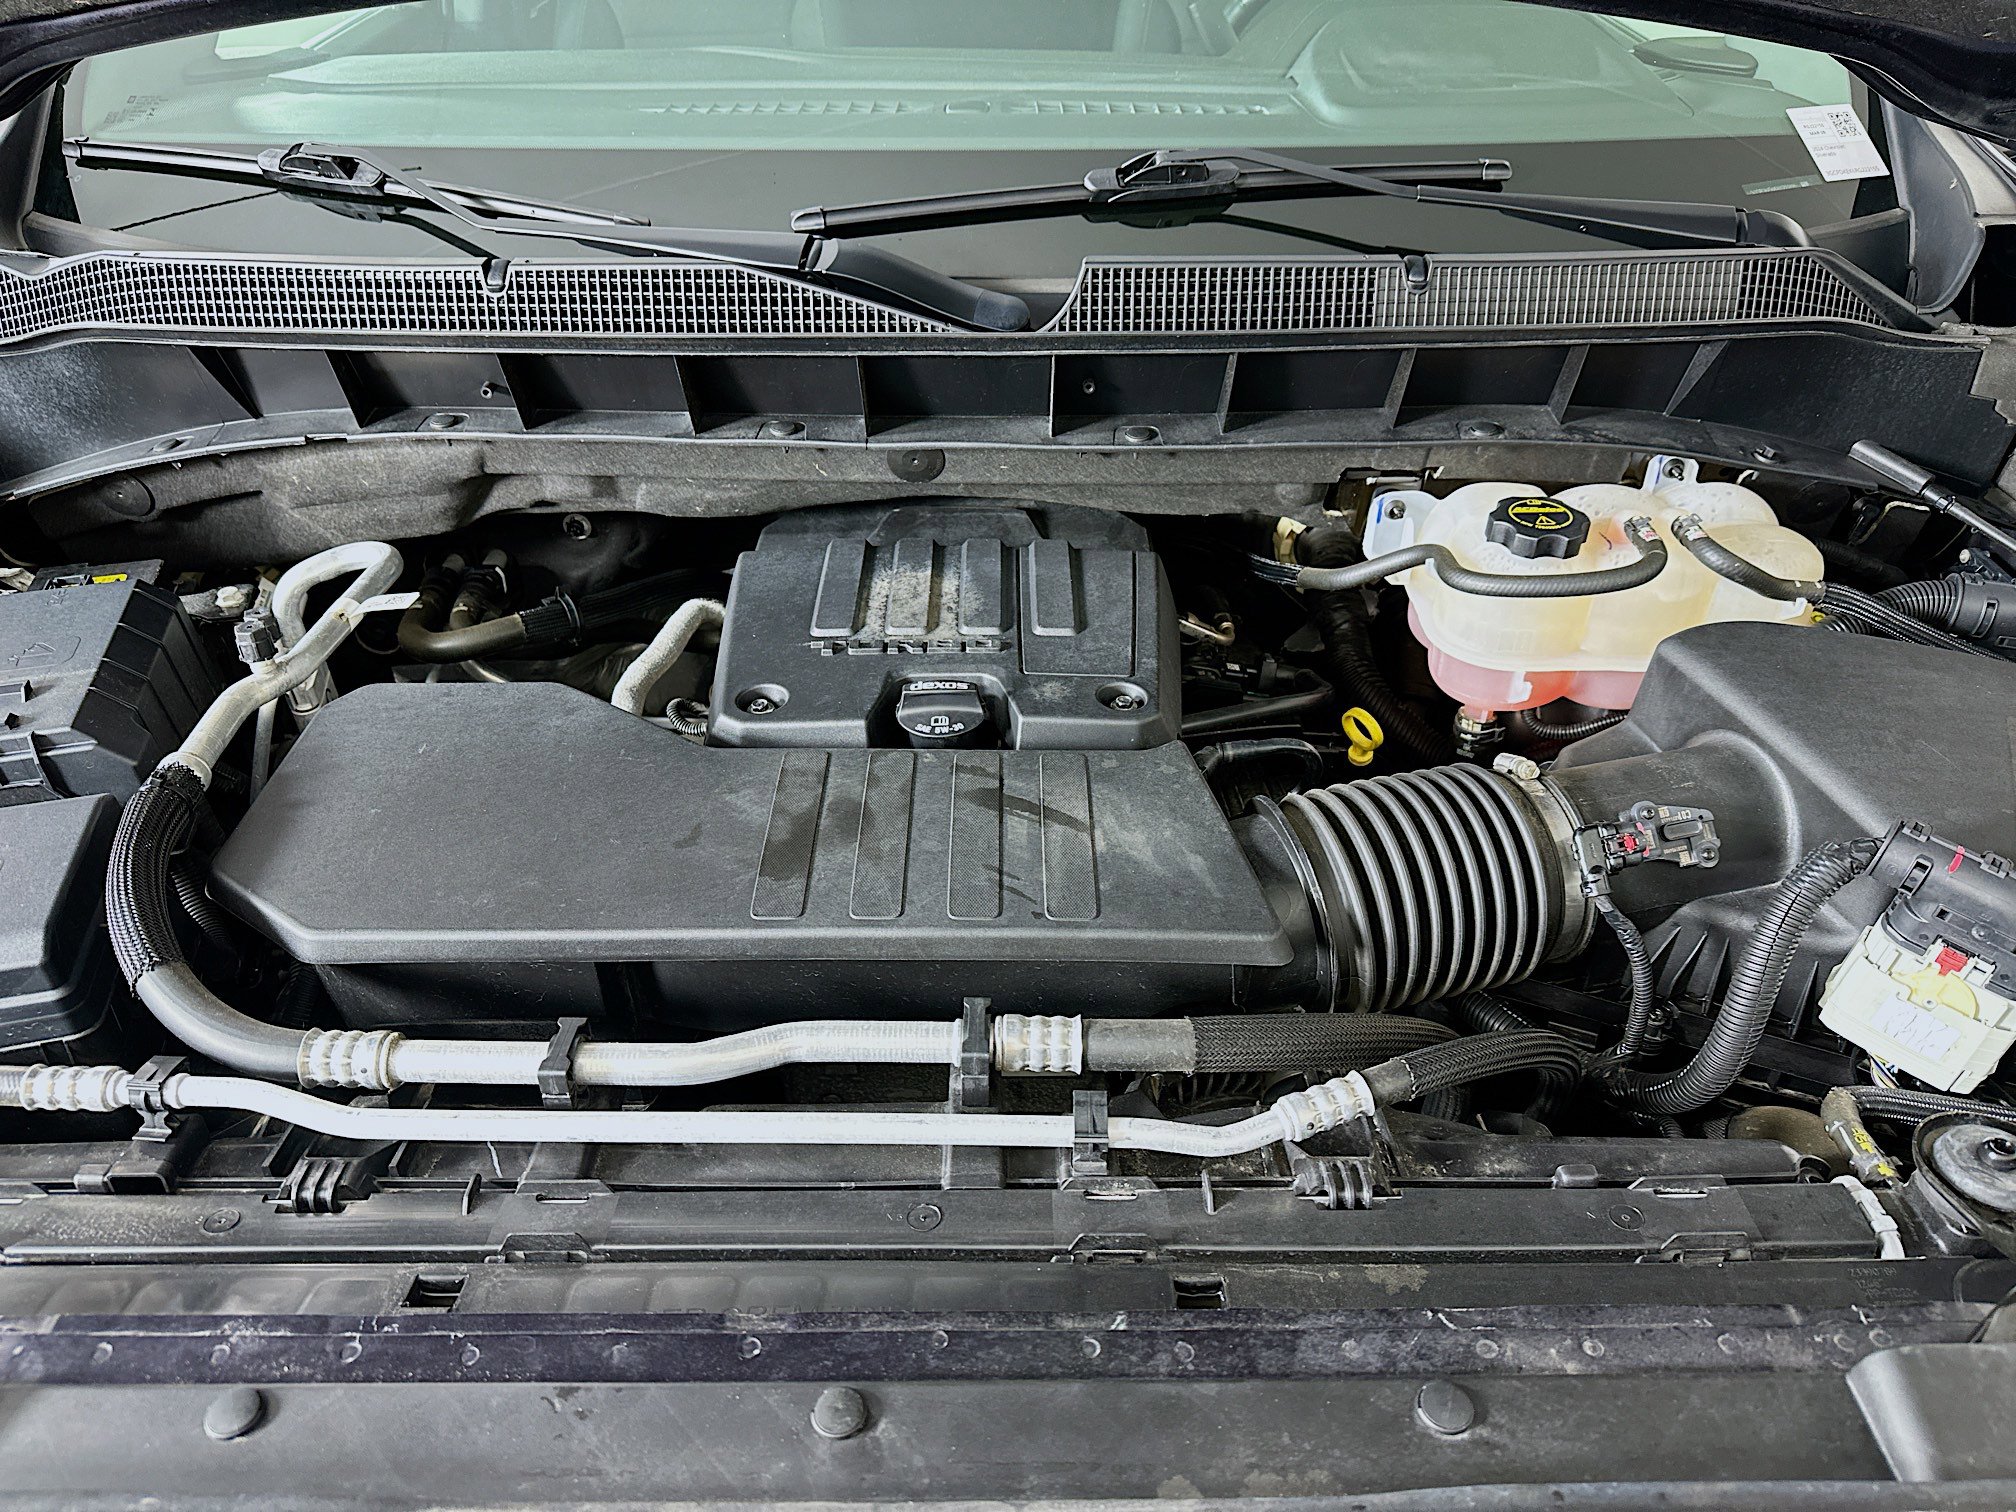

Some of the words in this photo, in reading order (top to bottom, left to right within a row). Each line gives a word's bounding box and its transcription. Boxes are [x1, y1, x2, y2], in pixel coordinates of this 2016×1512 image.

[909, 681, 970, 691] dexos
[914, 723, 932, 734] SAE
[934, 722, 965, 734] 5W-30
